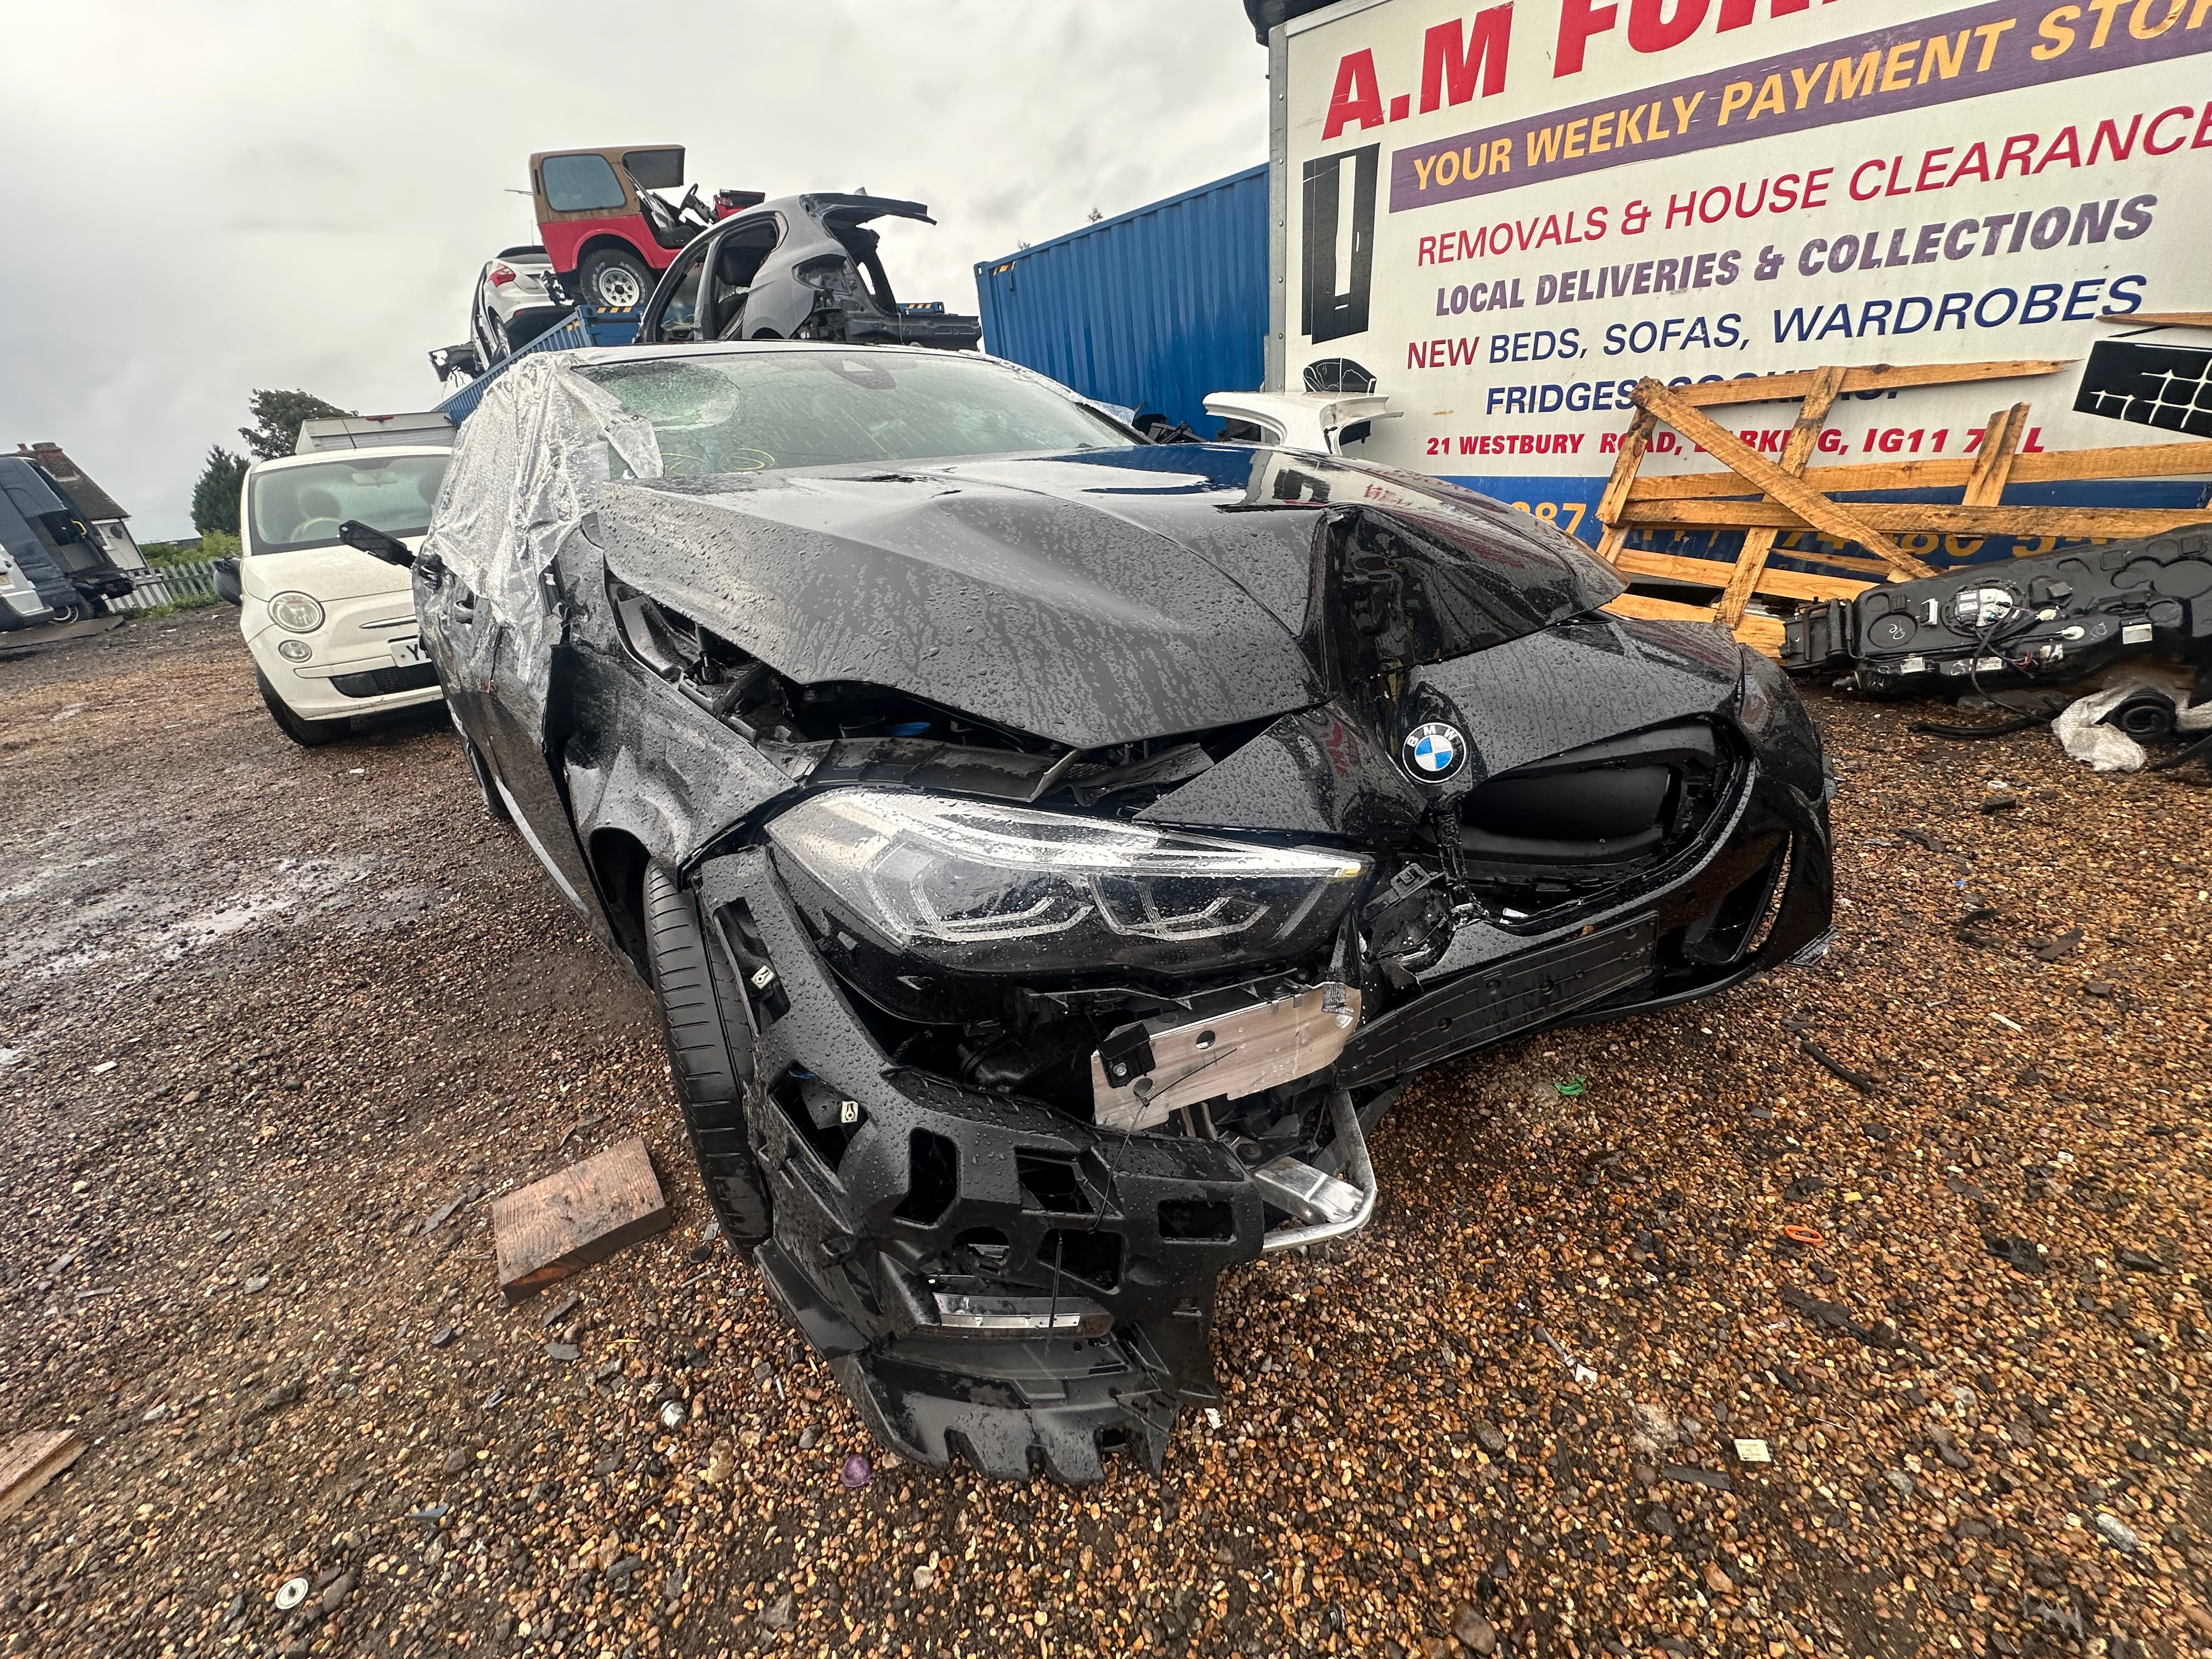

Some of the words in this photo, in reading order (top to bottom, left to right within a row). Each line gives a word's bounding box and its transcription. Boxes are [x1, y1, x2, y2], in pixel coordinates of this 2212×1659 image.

[1323, 3, 1512, 139] A.M
[1414, 138, 1511, 189] YOUR
[1527, 91, 1703, 166] WEEKLY
[1718, 19, 2016, 125] PAYMENT
[1419, 207, 1607, 265] REMOVALS
[1621, 201, 1651, 235] &
[1666, 168, 1833, 228] HOUSE
[1436, 278, 1524, 316] LOCAL
[1536, 250, 1741, 305] DELIVERIES
[1754, 245, 1784, 280] &
[1799, 195, 2157, 276] COLLECTIONS
[1408, 336, 1480, 369] NEW
[1489, 328, 1587, 363] BEDS,
[1604, 314, 1749, 355] SOFAS,
[1774, 275, 2147, 343] WARDROBES
[1427, 437, 1451, 455] 21
[1460, 434, 1584, 454] WESTBURY
[1863, 428, 1948, 453] IG11
[1962, 427, 2044, 454] 7L
[1407, 725, 1457, 748] BMW
